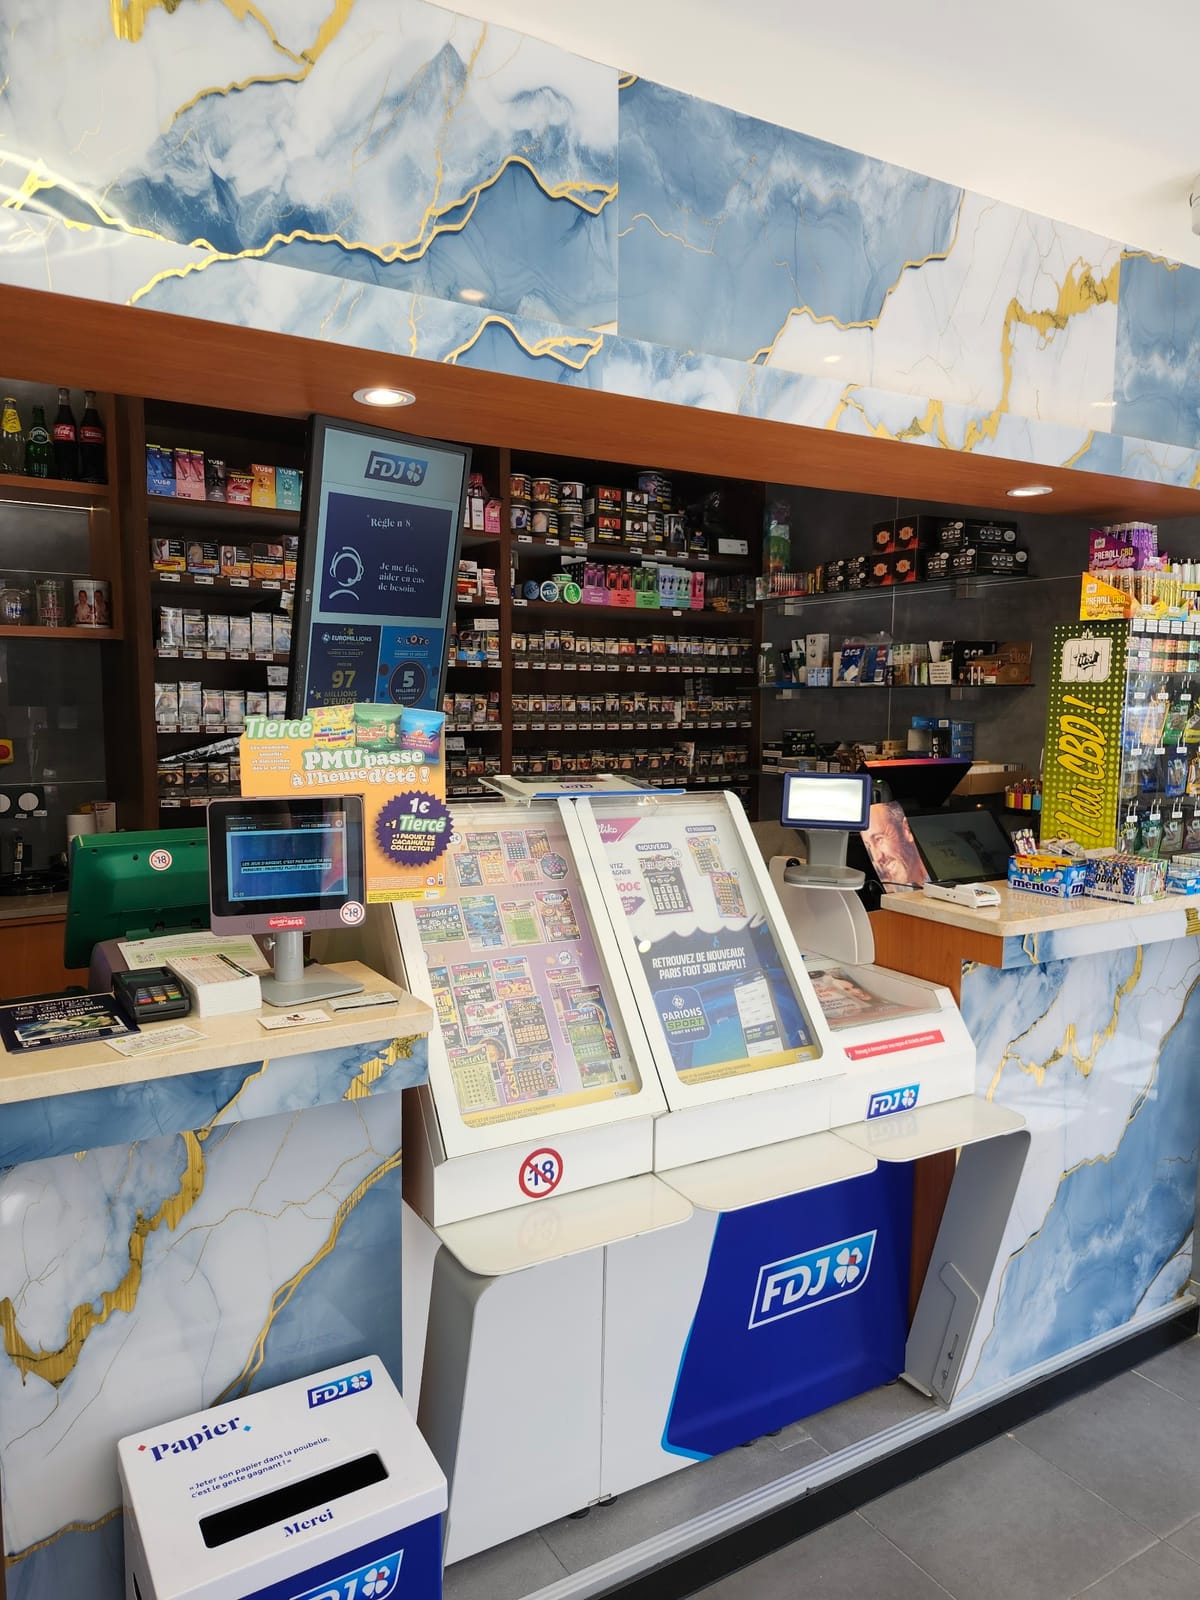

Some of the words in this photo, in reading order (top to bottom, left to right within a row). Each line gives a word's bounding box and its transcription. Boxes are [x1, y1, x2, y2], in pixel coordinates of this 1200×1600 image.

[369, 456, 405, 479] FDJ
[370, 518, 395, 529] Règle
[942, 530, 960, 540] OCB
[980, 528, 1002, 540] OCB
[954, 557, 972, 567] OCB
[992, 554, 1013, 566] OCB
[1094, 549, 1120, 560] PREROLL
[1121, 547, 1133, 557] CBD
[380, 562, 389, 570] Je
[405, 564, 418, 572] fais
[928, 560, 946, 570] OCB
[379, 572, 399, 582] aider
[378, 582, 388, 591] de
[390, 584, 417, 593] besoin.
[1086, 596, 1111, 606] PREROLL
[1113, 596, 1125, 604] CBD
[332, 634, 372, 642] EUROMILLIONS
[405, 634, 430, 645] LOTO
[332, 670, 356, 689] 97
[403, 671, 414, 688] 5
[1062, 694, 1107, 714] !
[246, 716, 312, 738] Tiercé
[1056, 714, 1108, 780] CBD
[304, 750, 362, 770] PMU
[364, 751, 423, 769] passe
[293, 773, 303, 786] à
[306, 770, 366, 785] l'heure
[369, 766, 416, 783] d'été
[420, 768, 429, 783] !
[410, 798, 430, 813] 1€
[400, 814, 446, 833] Tiercé
[154, 855, 167, 864] -18
[1013, 878, 1060, 895] mentos
[345, 908, 359, 918] -18
[652, 953, 695, 969] RETROUVEZ
[696, 952, 706, 962] DE
[706, 947, 745, 960] NOUVEAUX
[659, 968, 681, 980] PARIS
[683, 966, 701, 977] FOOT
[702, 963, 716, 975] SUR
[718, 959, 742, 972] L'APPLI
[662, 1007, 703, 1022] PARIONS
[666, 1017, 704, 1030] SPORT
[505, 1058, 519, 1098] CASH
[870, 1091, 899, 1116] FDJ
[528, 1160, 554, 1186] -18
[761, 1256, 831, 1313] FDJ
[311, 1382, 349, 1405] FDJ
[150, 1416, 240, 1462] Papier
[194, 1477, 218, 1489] Jeter
[218, 1471, 234, 1480] son
[235, 1460, 262, 1476] papier
[263, 1452, 283, 1464] dans
[284, 1449, 292, 1457] la
[191, 1487, 212, 1498] c'est
[222, 1475, 246, 1488] geste
[247, 1462, 282, 1479] gagnant
[283, 1508, 334, 1539] Merci
